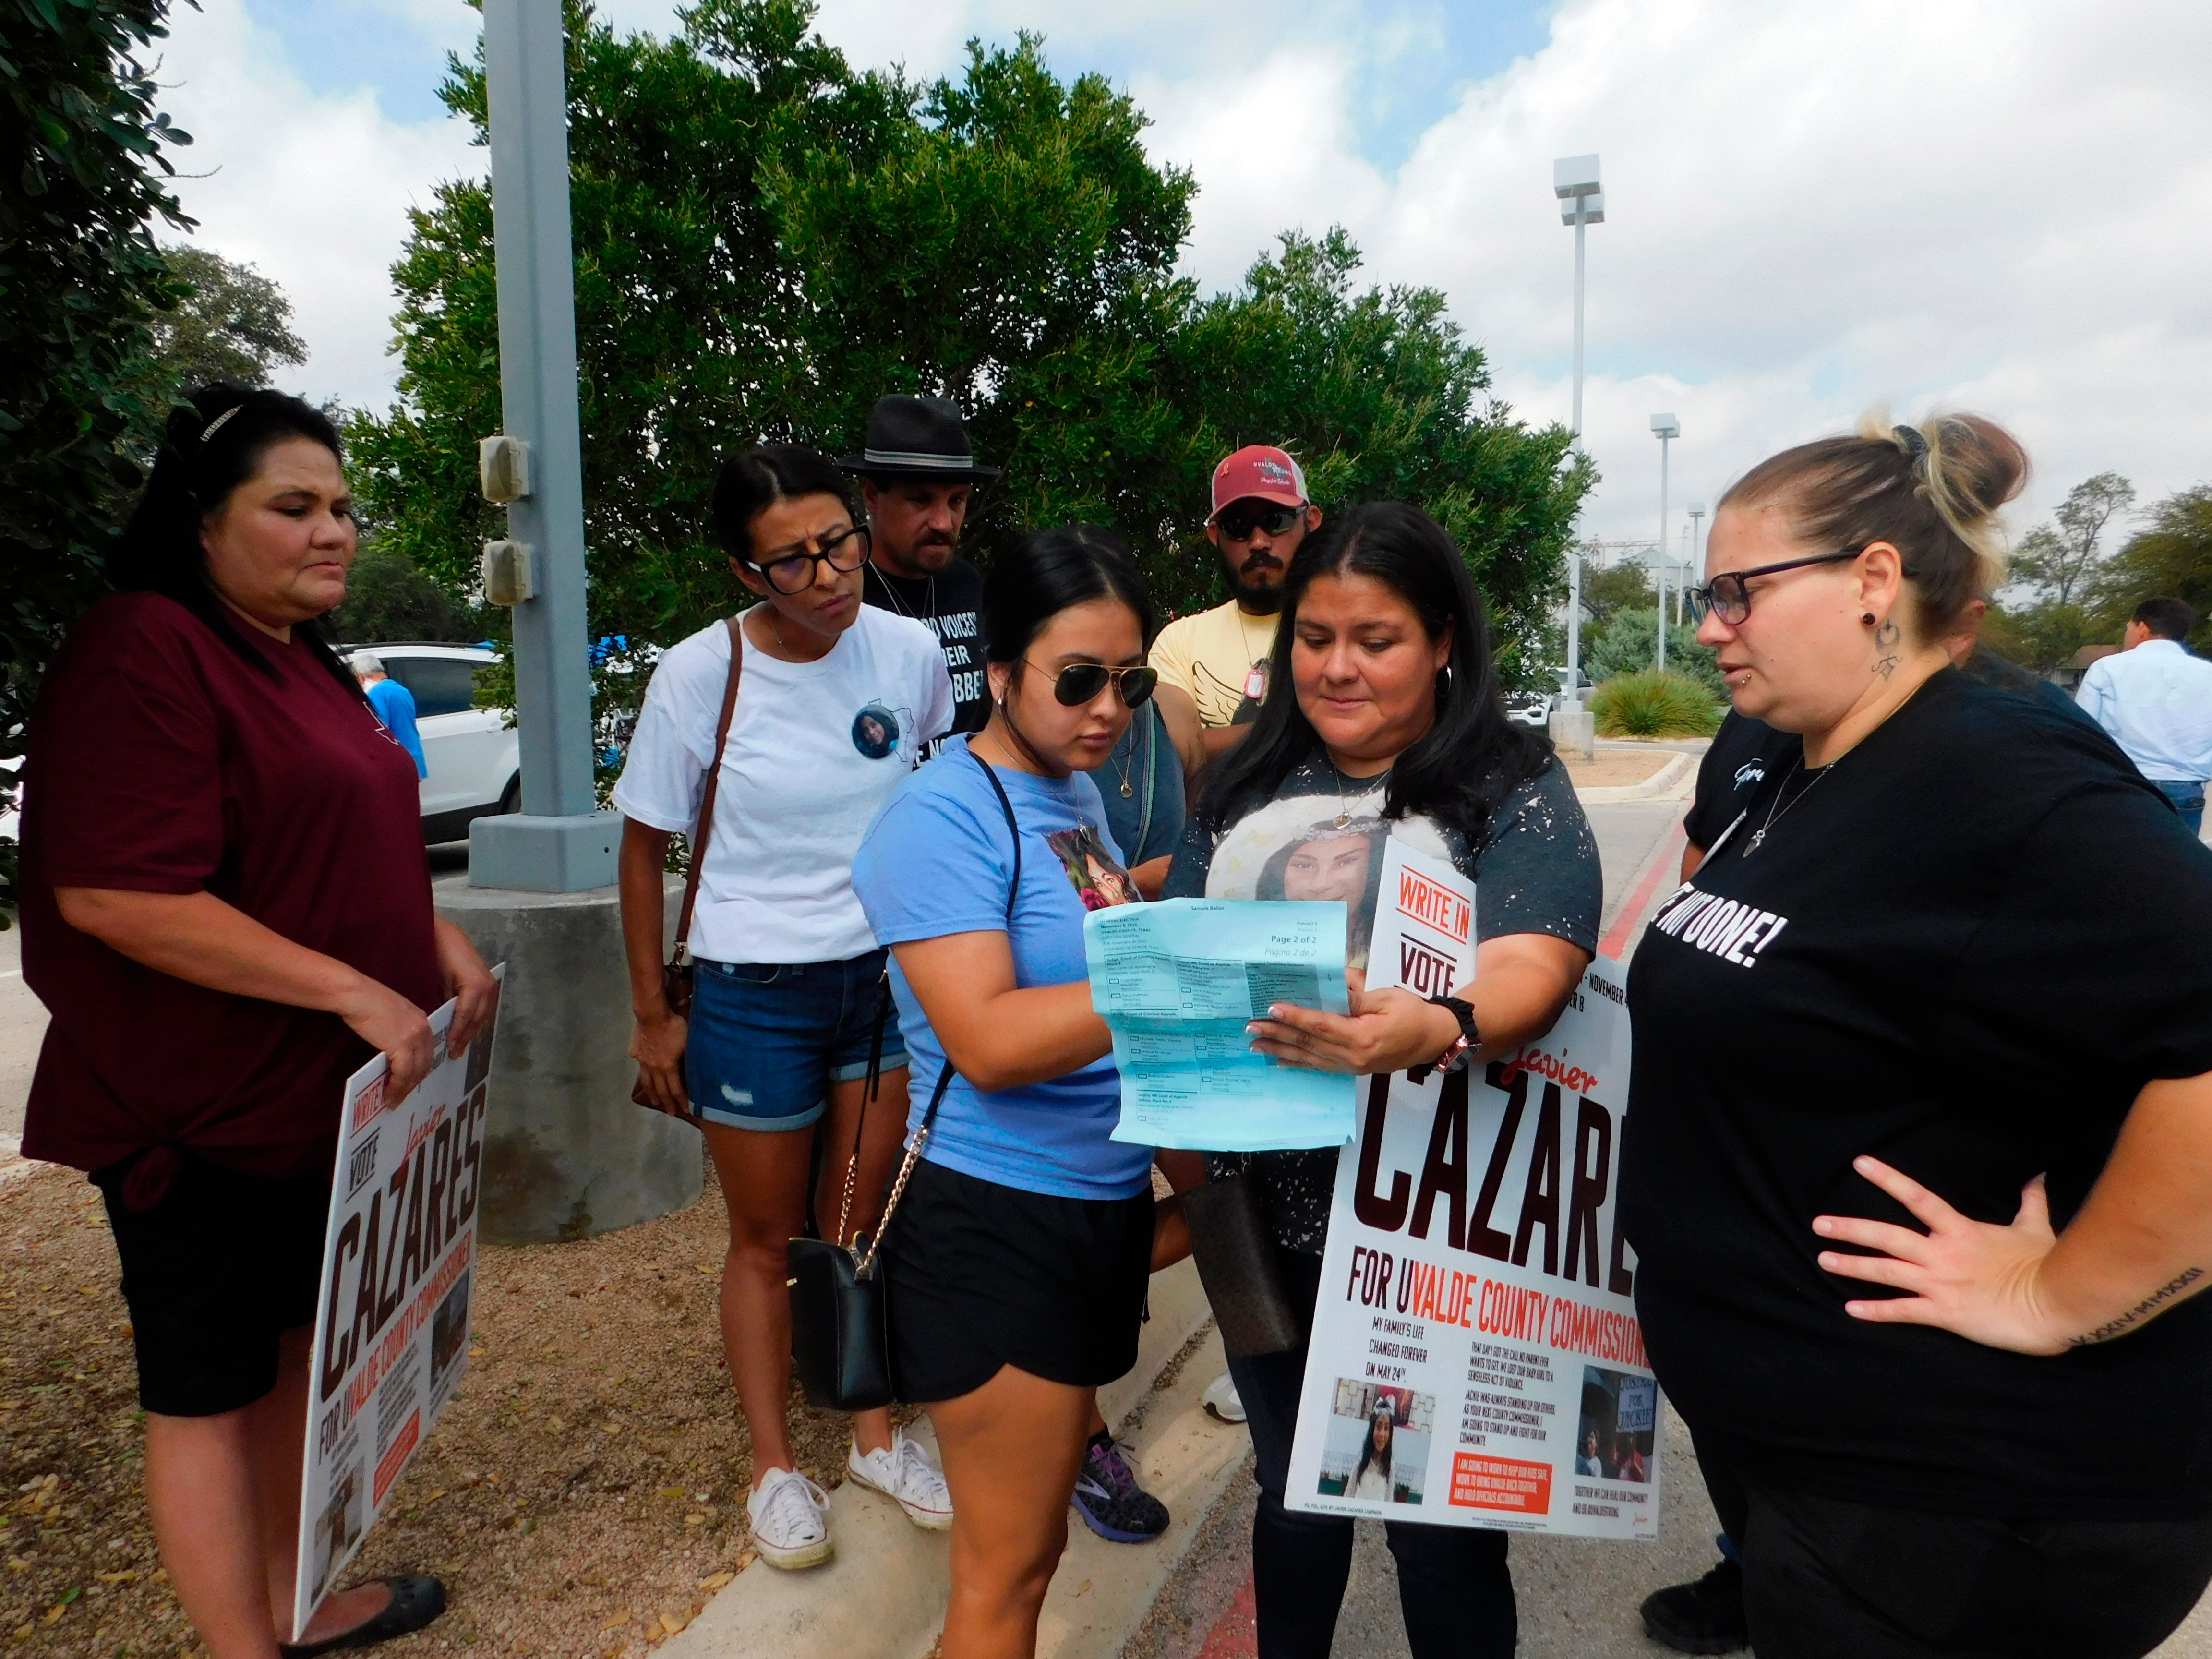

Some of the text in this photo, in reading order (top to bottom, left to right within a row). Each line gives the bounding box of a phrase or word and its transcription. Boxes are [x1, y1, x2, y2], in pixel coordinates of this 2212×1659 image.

[952, 670, 983, 703] BBE
[1400, 872, 1470, 939] WRITE IN
[1271, 935, 1291, 944] Page
[1682, 897, 1789, 968] DONE!
[1265, 948, 1290, 957] Página
[1400, 941, 1455, 998] VOTE
[1589, 973, 1623, 1006] NOVEMBER
[1579, 995, 1584, 1012] 8
[1500, 1045, 1598, 1094] Javier
[349, 1134, 379, 1191] VOTE
[321, 1082, 486, 1403] CAZARES
[1347, 1245, 1651, 1369] FOR UVALDE COUNTY COMMISSION
[1372, 1316, 1424, 1340] MY FAMILY'S LIFE
[1369, 1339, 1427, 1363] CHANGED FOREVER
[1472, 1342, 1482, 1353] THAT
[1482, 1344, 1491, 1355] DAY
[1493, 1346, 1502, 1358] GOT
[1510, 1350, 1519, 1361] CALL
[1366, 1362, 1375, 1377] ON
[1377, 1364, 1391, 1380] MAY
[1470, 1356, 1485, 1368] WANTS
[1486, 1358, 1491, 1370] TO
[1500, 1361, 1507, 1372] WE
[1507, 1363, 1516, 1375] LOST
[1467, 1370, 1491, 1384] SENSELESS
[1491, 1374, 1499, 1385] ACT
[1499, 1375, 1505, 1386] OF
[1463, 1403, 1469, 1414] AS
[1480, 1392, 1491, 1403] WAS
[1490, 1393, 1507, 1407] ALWAYS
[1629, 1394, 1644, 1407] FOR
[318, 1399, 340, 1466] FOR
[1461, 1418, 1468, 1429] AM
